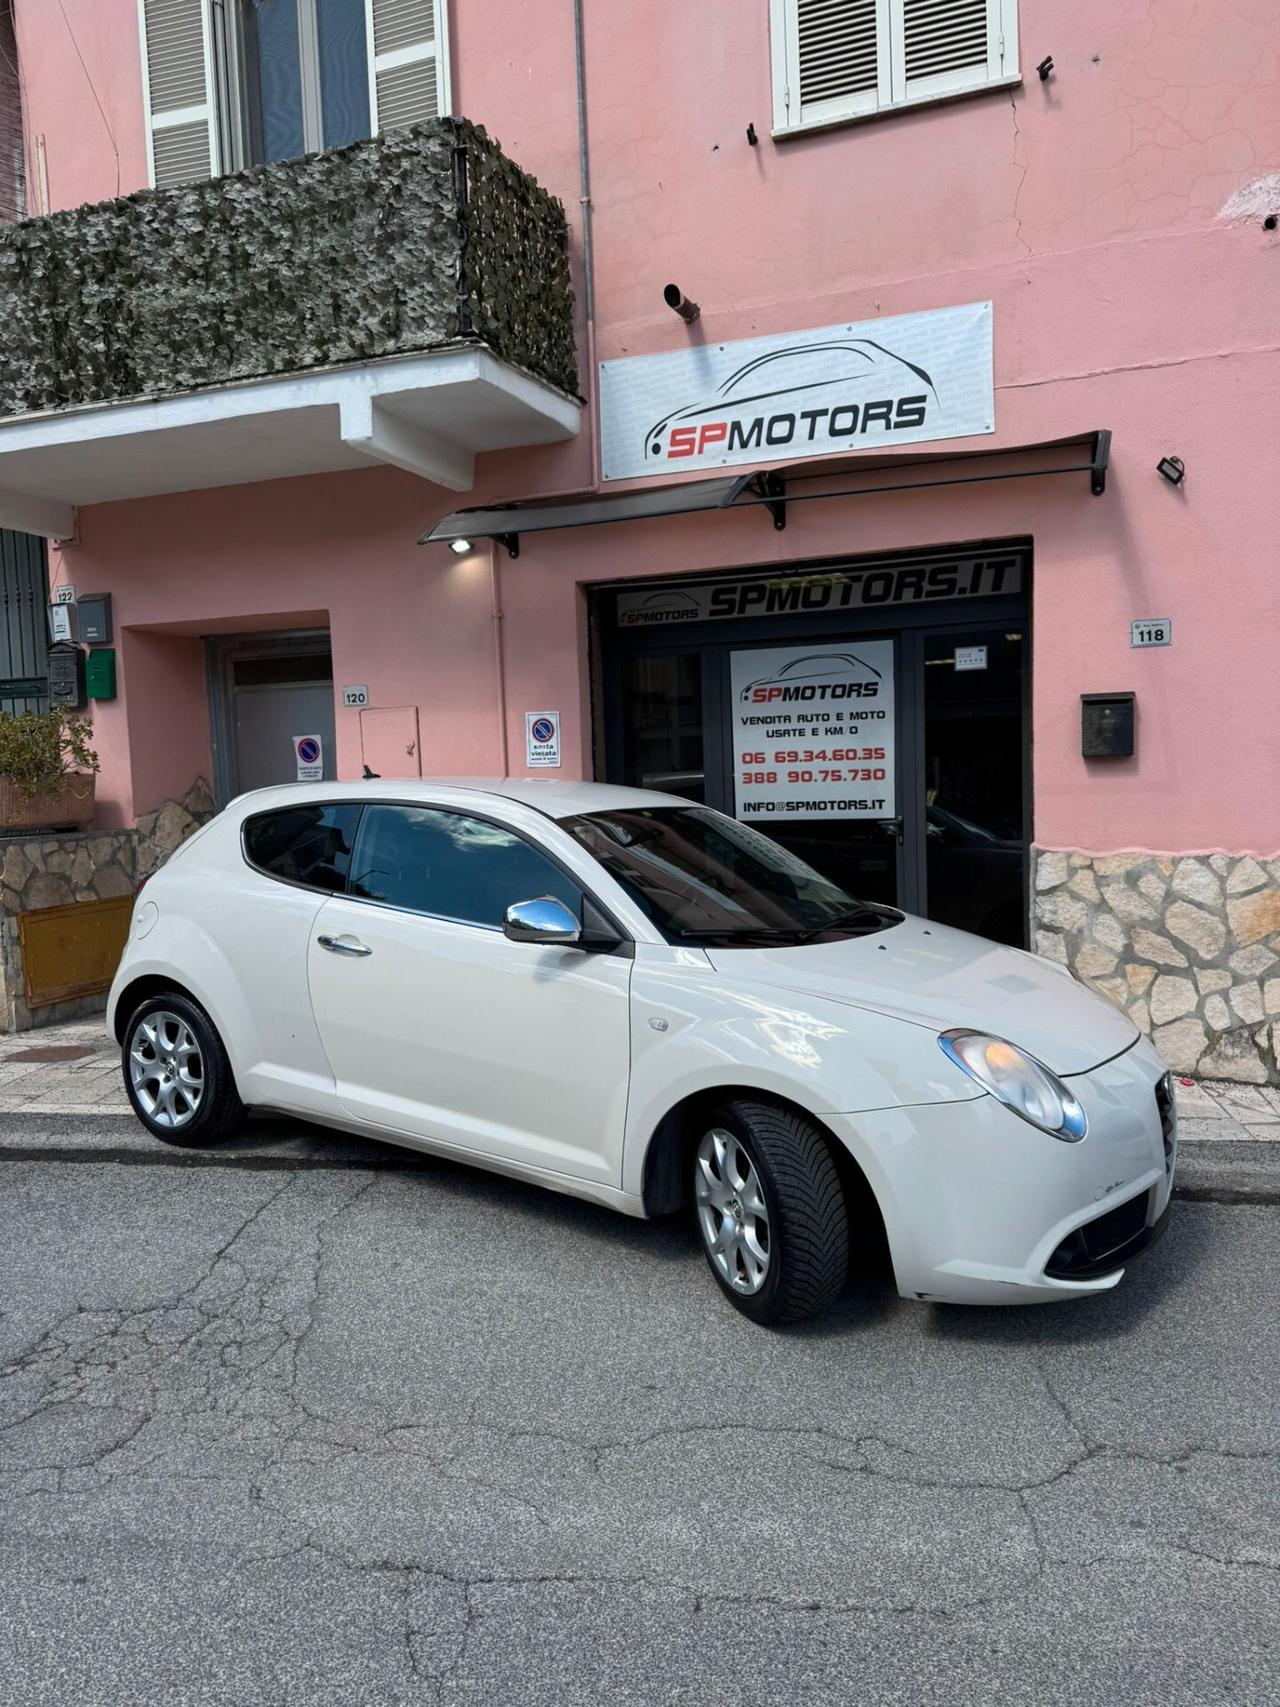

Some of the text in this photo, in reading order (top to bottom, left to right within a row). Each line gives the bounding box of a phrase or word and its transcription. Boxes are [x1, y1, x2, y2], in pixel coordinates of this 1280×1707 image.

[667, 394, 928, 458] SPMOTORS
[709, 559, 1017, 617] SPMOTORS.IT
[58, 591, 72, 601] 122
[1138, 629, 1164, 642] 118
[346, 693, 365, 704] 120
[752, 682, 879, 703] SPMOTORS
[741, 710, 886, 725] VENDITA AUTO E MOTO
[766, 728, 806, 738] USATE
[812, 727, 819, 736] E
[742, 747, 885, 764] 06 69.34.60.35
[742, 768, 886, 784] 388 90.75.730
[743, 799, 886, 812] INFO@SPMOTORS.IT
